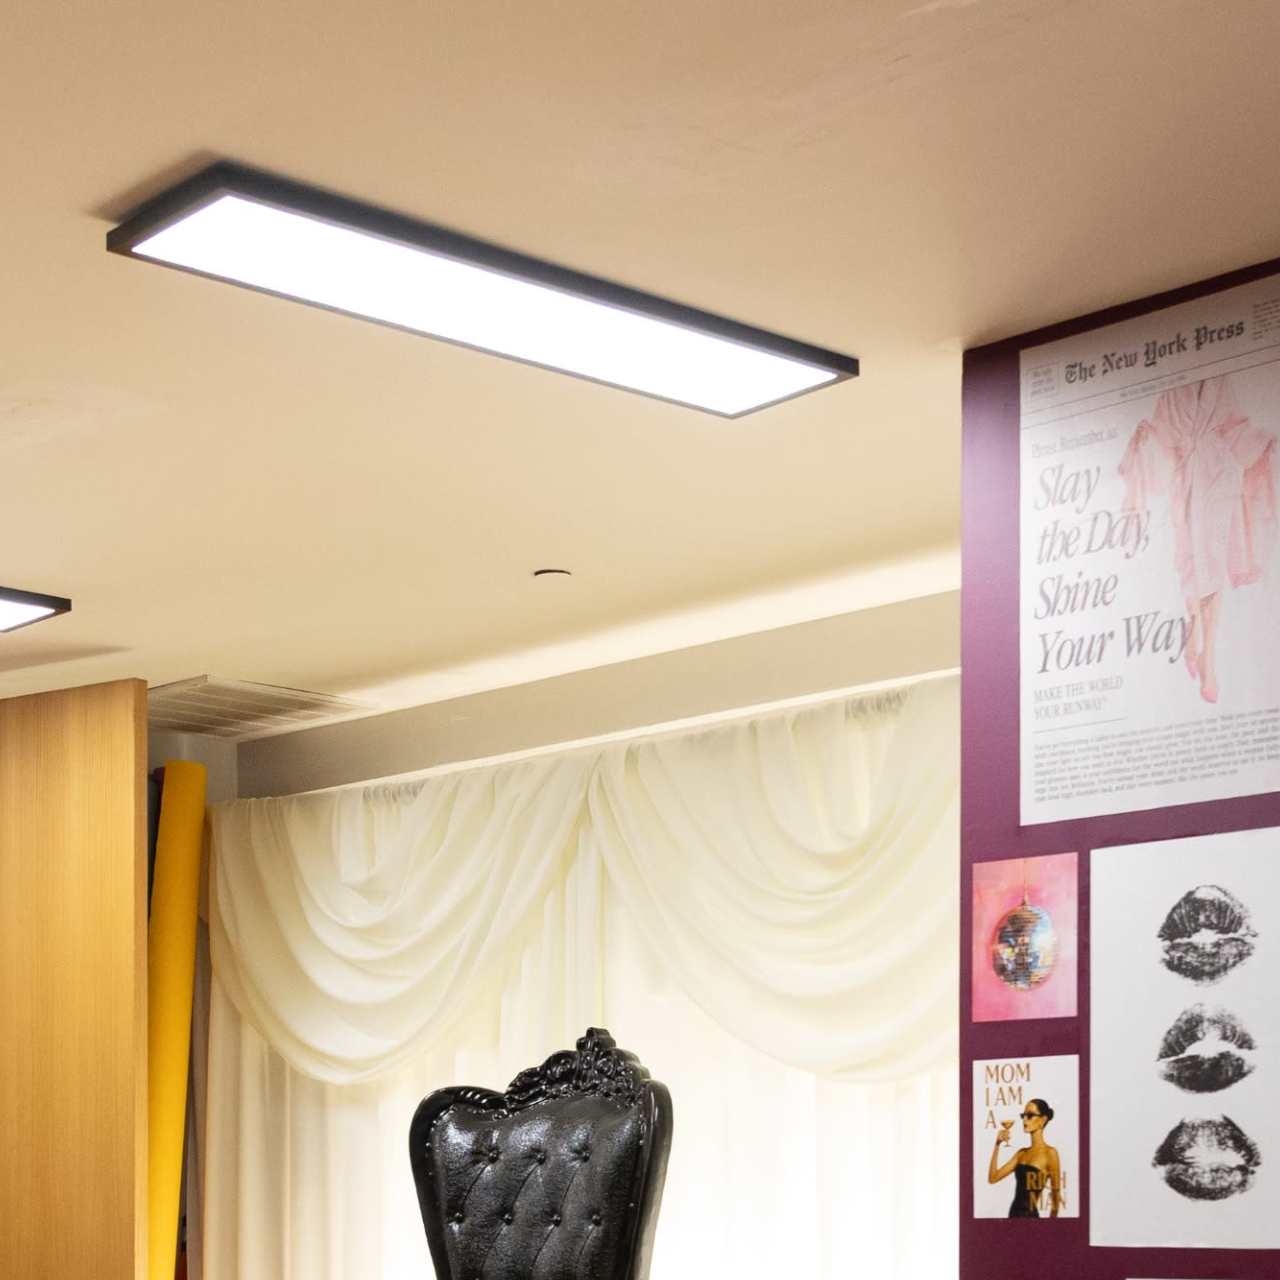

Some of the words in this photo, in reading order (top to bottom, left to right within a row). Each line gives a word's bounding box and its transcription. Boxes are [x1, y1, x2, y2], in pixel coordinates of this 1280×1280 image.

[1064, 362, 1096, 384] The
[1102, 351, 1138, 376] New
[1143, 334, 1188, 368] York
[1194, 320, 1246, 351] Press
[1033, 463, 1102, 514] Slay
[1036, 519, 1081, 565] the
[1084, 509, 1151, 560] Day,
[1033, 570, 1119, 621] Shine
[1036, 629, 1115, 675] Your
[1121, 610, 1197, 665] Way
[985, 1063, 1031, 1084] MOM
[985, 1110, 997, 1129] A
